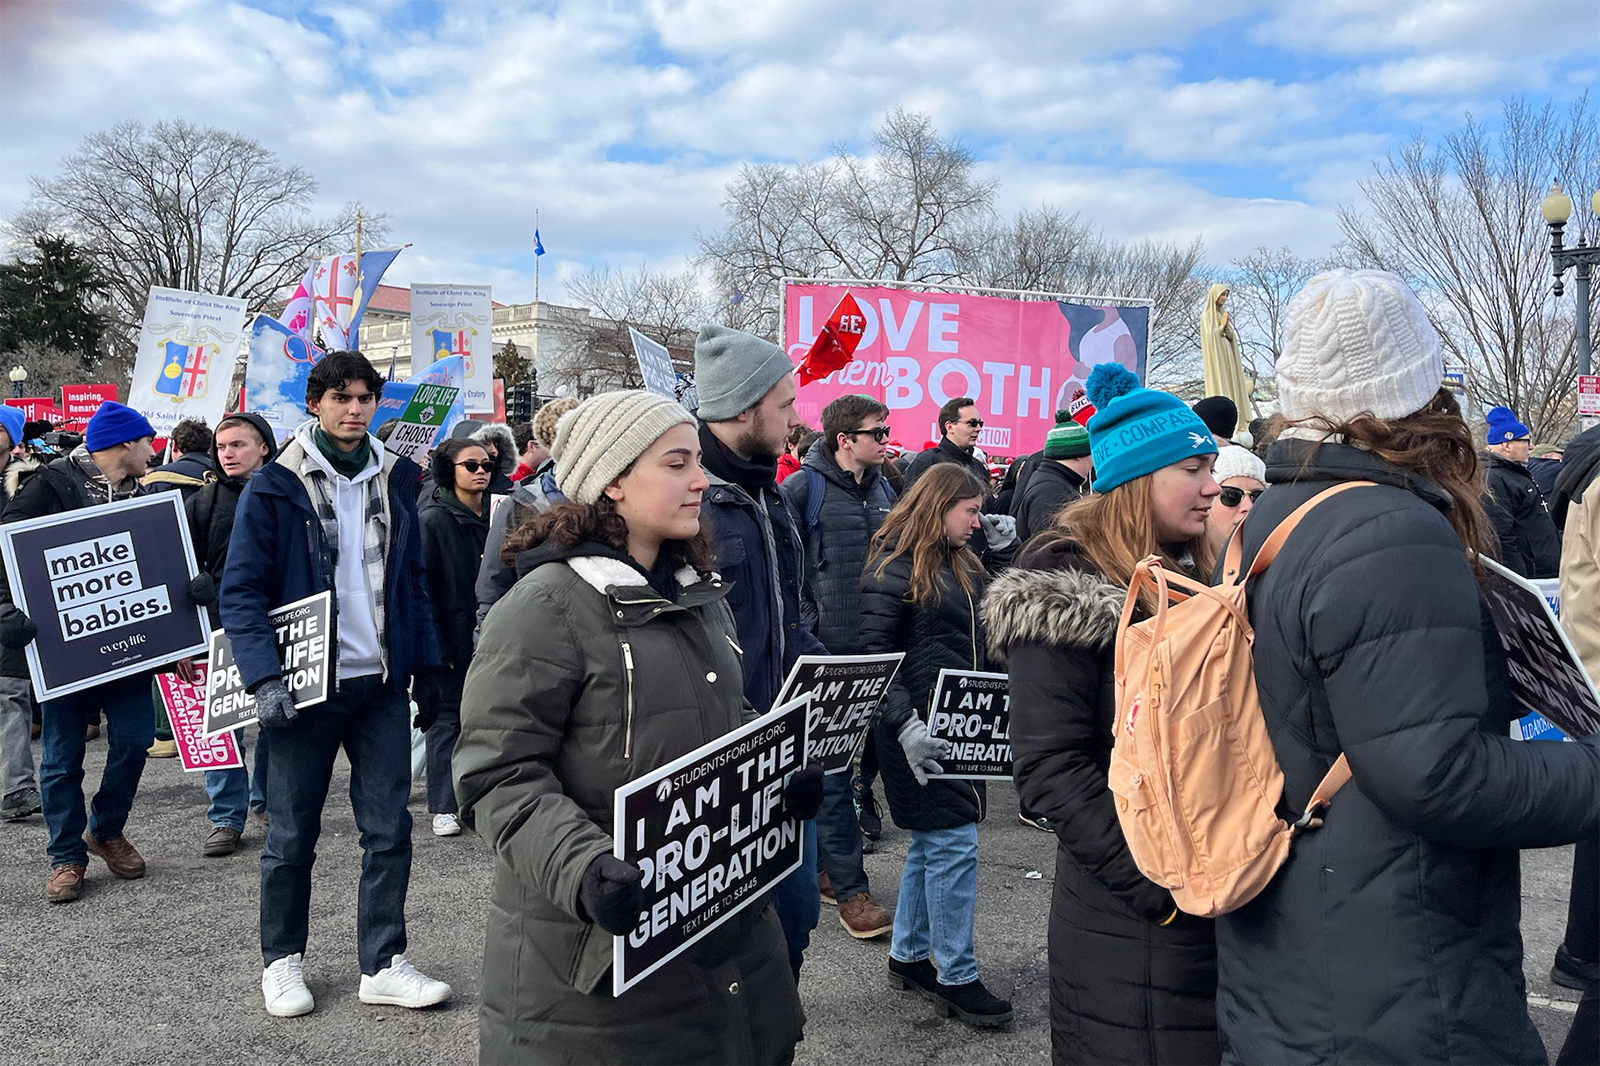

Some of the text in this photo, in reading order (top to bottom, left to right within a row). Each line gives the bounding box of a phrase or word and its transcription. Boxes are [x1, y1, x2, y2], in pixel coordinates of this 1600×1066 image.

[155, 294, 183, 304] Institute
[799, 296, 960, 353] LOVE
[414, 385, 440, 405] LOVE
[436, 387, 458, 406] LIFE
[887, 356, 1051, 419] BOTH
[69, 404, 102, 412] Remarka
[396, 425, 435, 444] CHOOSE
[976, 428, 1009, 445] CTION
[1092, 443, 1112, 466] OVE
[51, 542, 129, 576] make
[57, 570, 134, 603] more
[64, 601, 168, 637] babies.
[276, 616, 318, 644] THE
[1491, 589, 1562, 654] THE
[812, 681, 845, 702] AM
[848, 677, 886, 700] THE
[944, 691, 951, 708] I
[958, 691, 993, 711] AM
[165, 673, 200, 764] PARENTHOOD
[178, 680, 213, 764] LANNED
[809, 700, 878, 734] O-LIFE
[674, 721, 786, 791] STUDENTSFORLIFE.ORG
[808, 731, 860, 758] RATION
[636, 735, 795, 851] I AM THE
[629, 818, 796, 948] GENERATION
[682, 877, 758, 936] TEXT LIFE TO 53445
